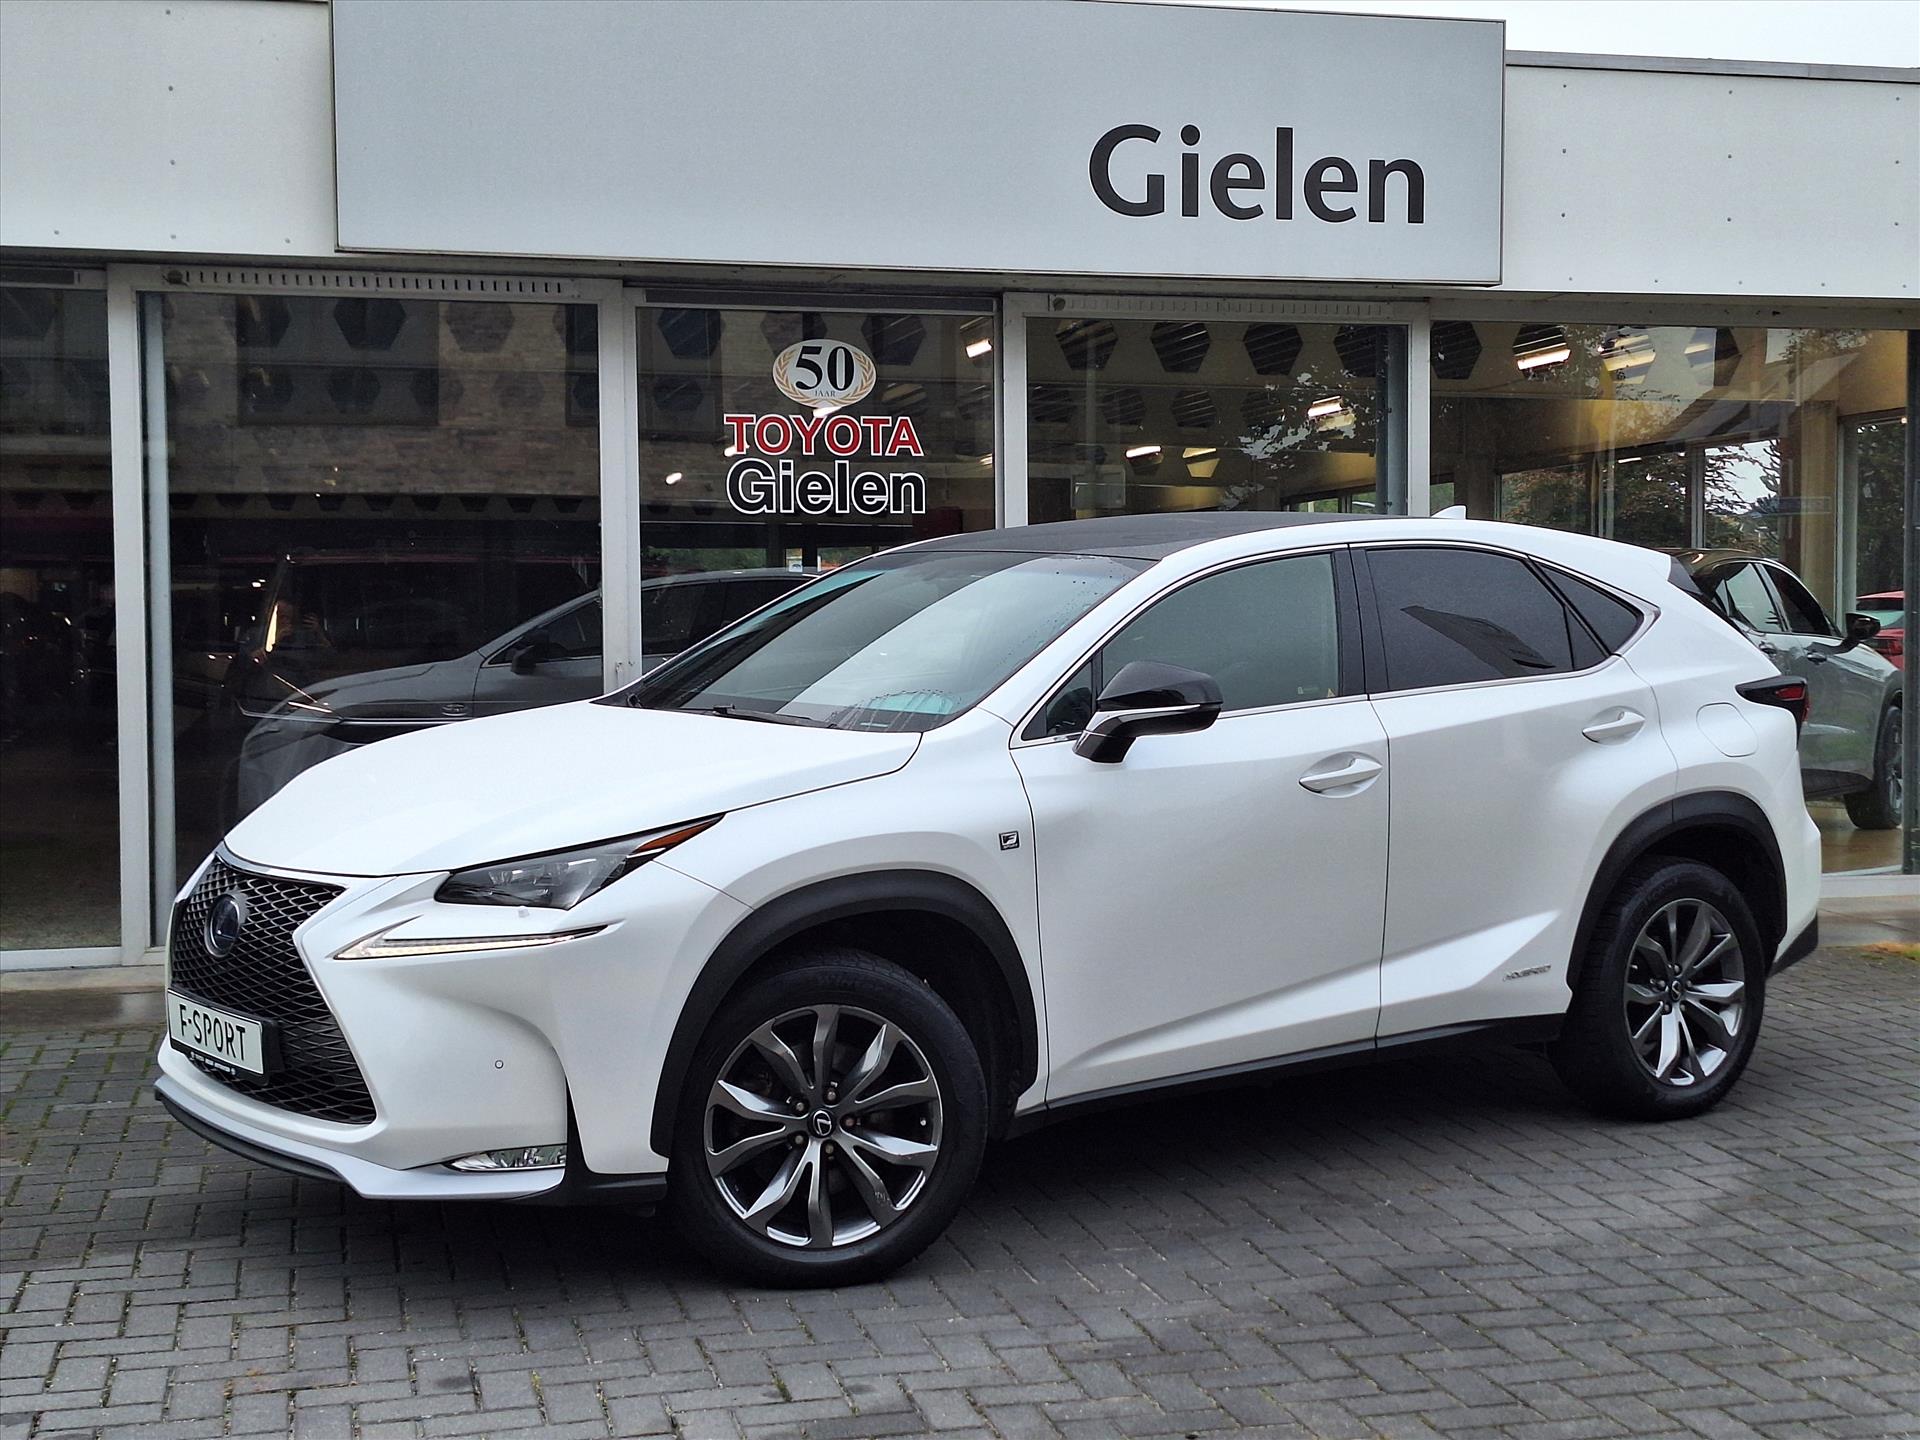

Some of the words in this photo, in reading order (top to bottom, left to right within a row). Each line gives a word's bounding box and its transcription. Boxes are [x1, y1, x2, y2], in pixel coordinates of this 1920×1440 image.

[1089, 124, 1424, 224] Gielen
[795, 346, 854, 391] 50
[724, 414, 924, 456] TOYOTA
[726, 458, 926, 514] Gielen
[179, 1004, 246, 1061] F-SPORT
